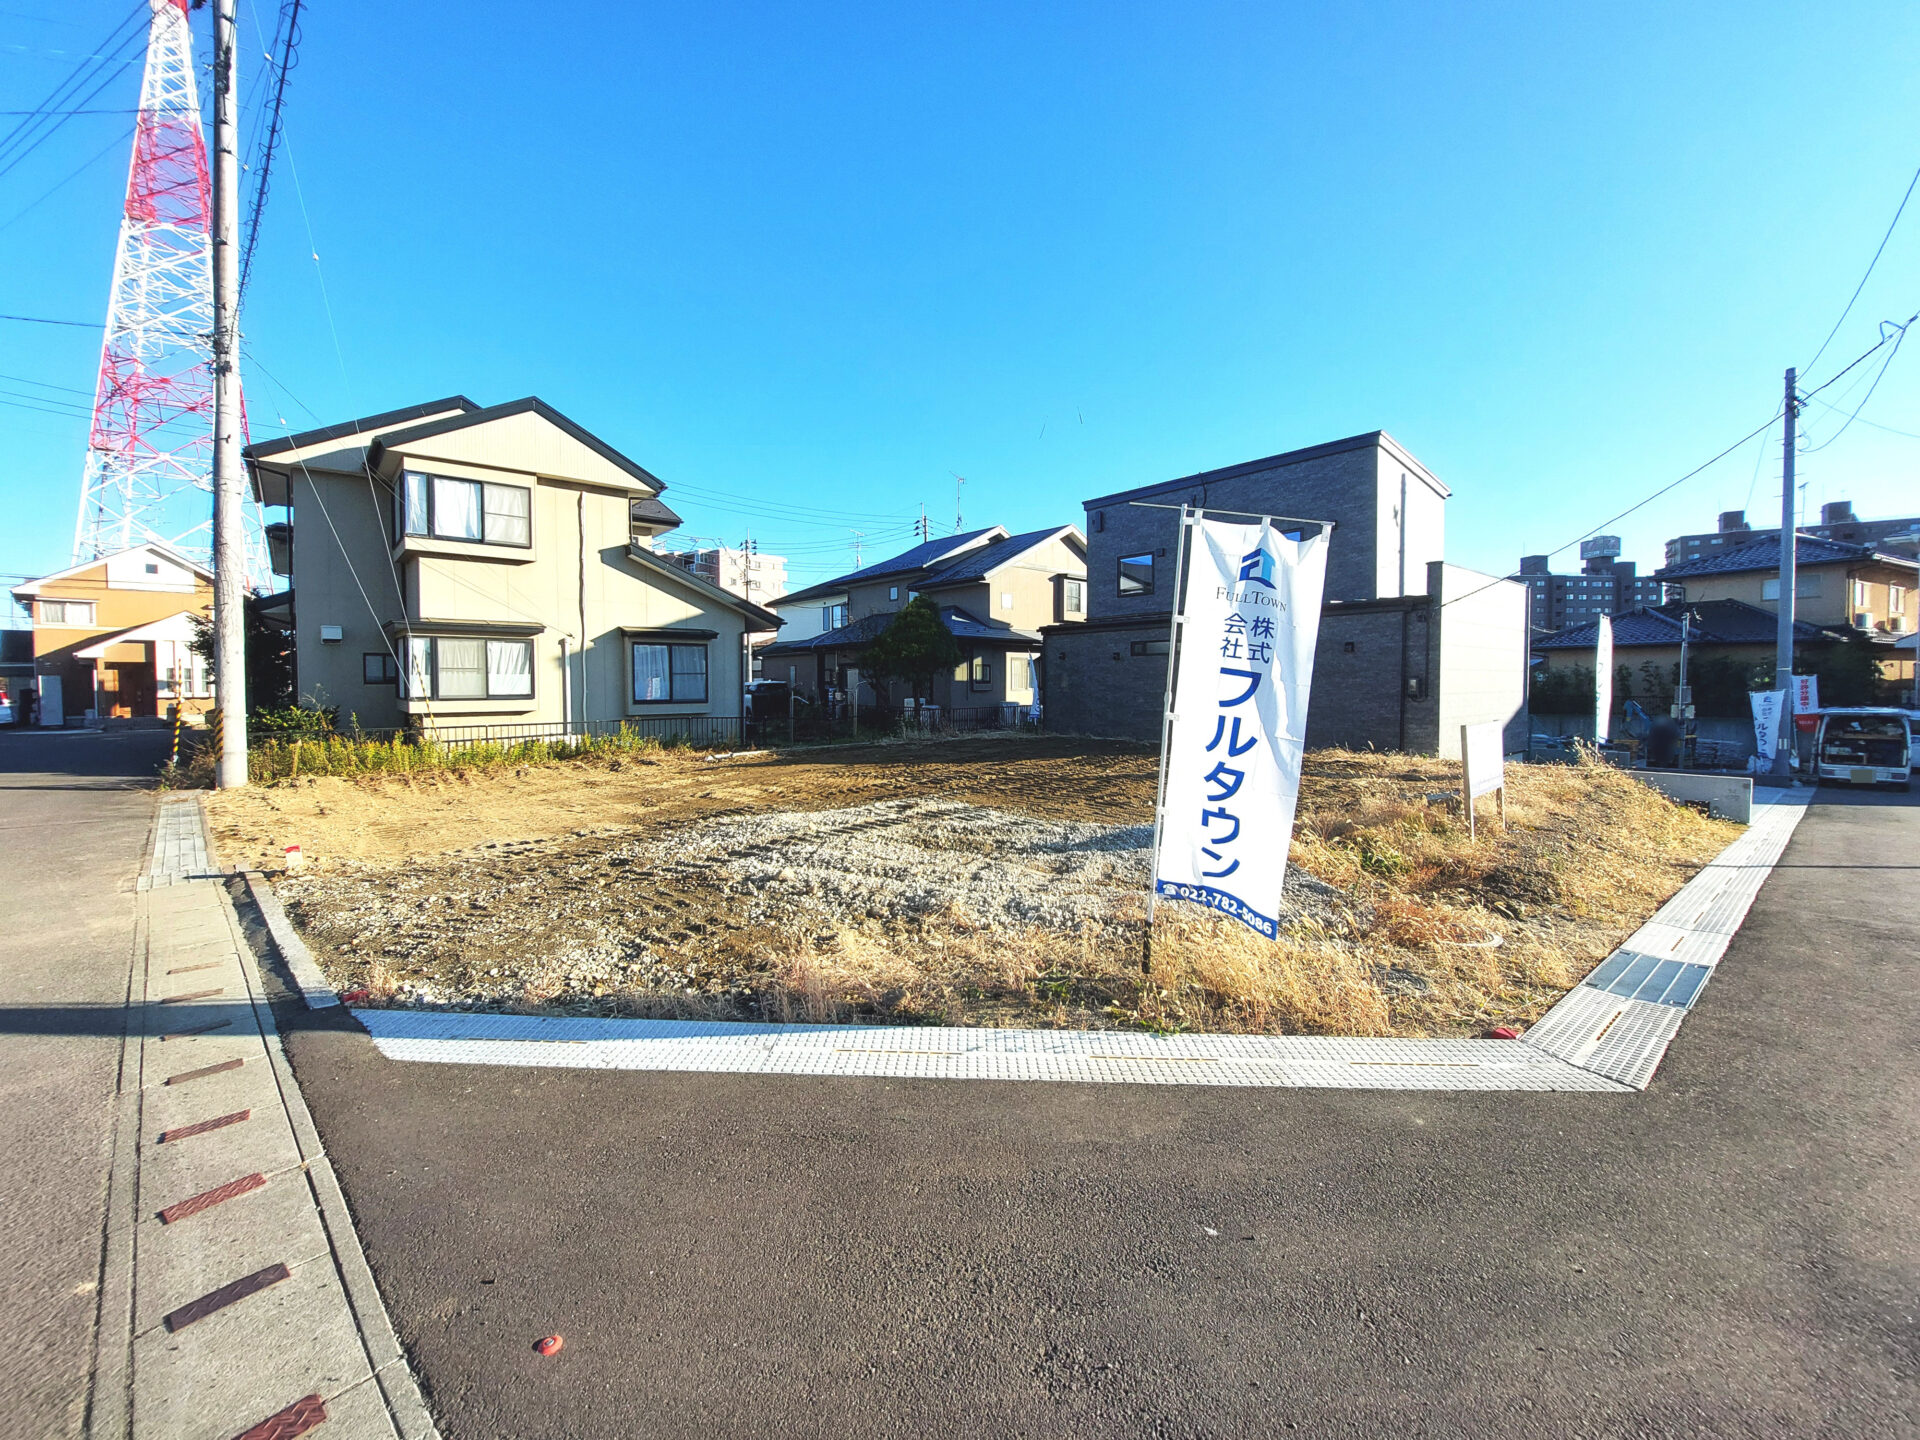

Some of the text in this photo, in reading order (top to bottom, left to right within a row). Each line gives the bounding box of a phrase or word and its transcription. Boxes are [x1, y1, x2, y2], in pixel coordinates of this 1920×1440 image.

[1201, 667, 1262, 878] フルタウン
